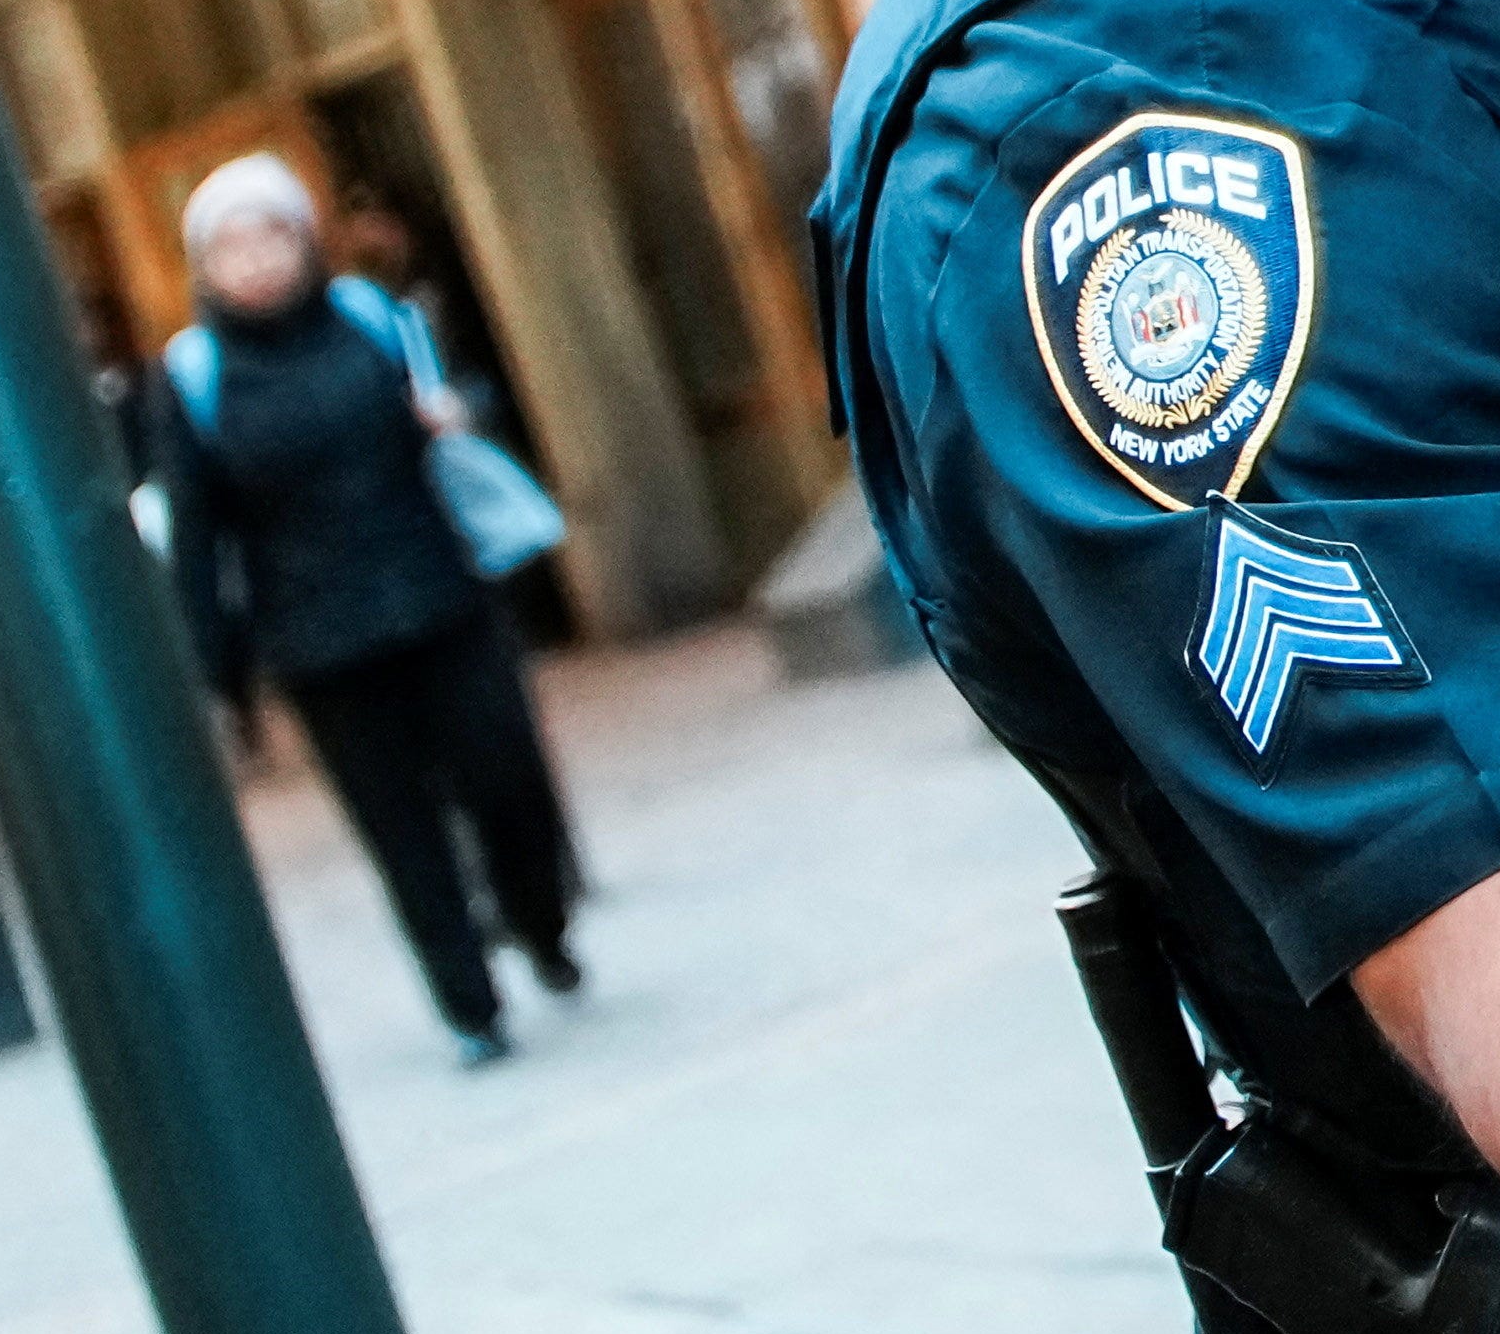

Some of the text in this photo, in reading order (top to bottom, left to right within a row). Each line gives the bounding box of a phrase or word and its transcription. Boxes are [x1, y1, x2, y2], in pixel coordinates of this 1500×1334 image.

[1052, 151, 1267, 285] POLICE
[1109, 379, 1271, 467] NEW YORK STATE
